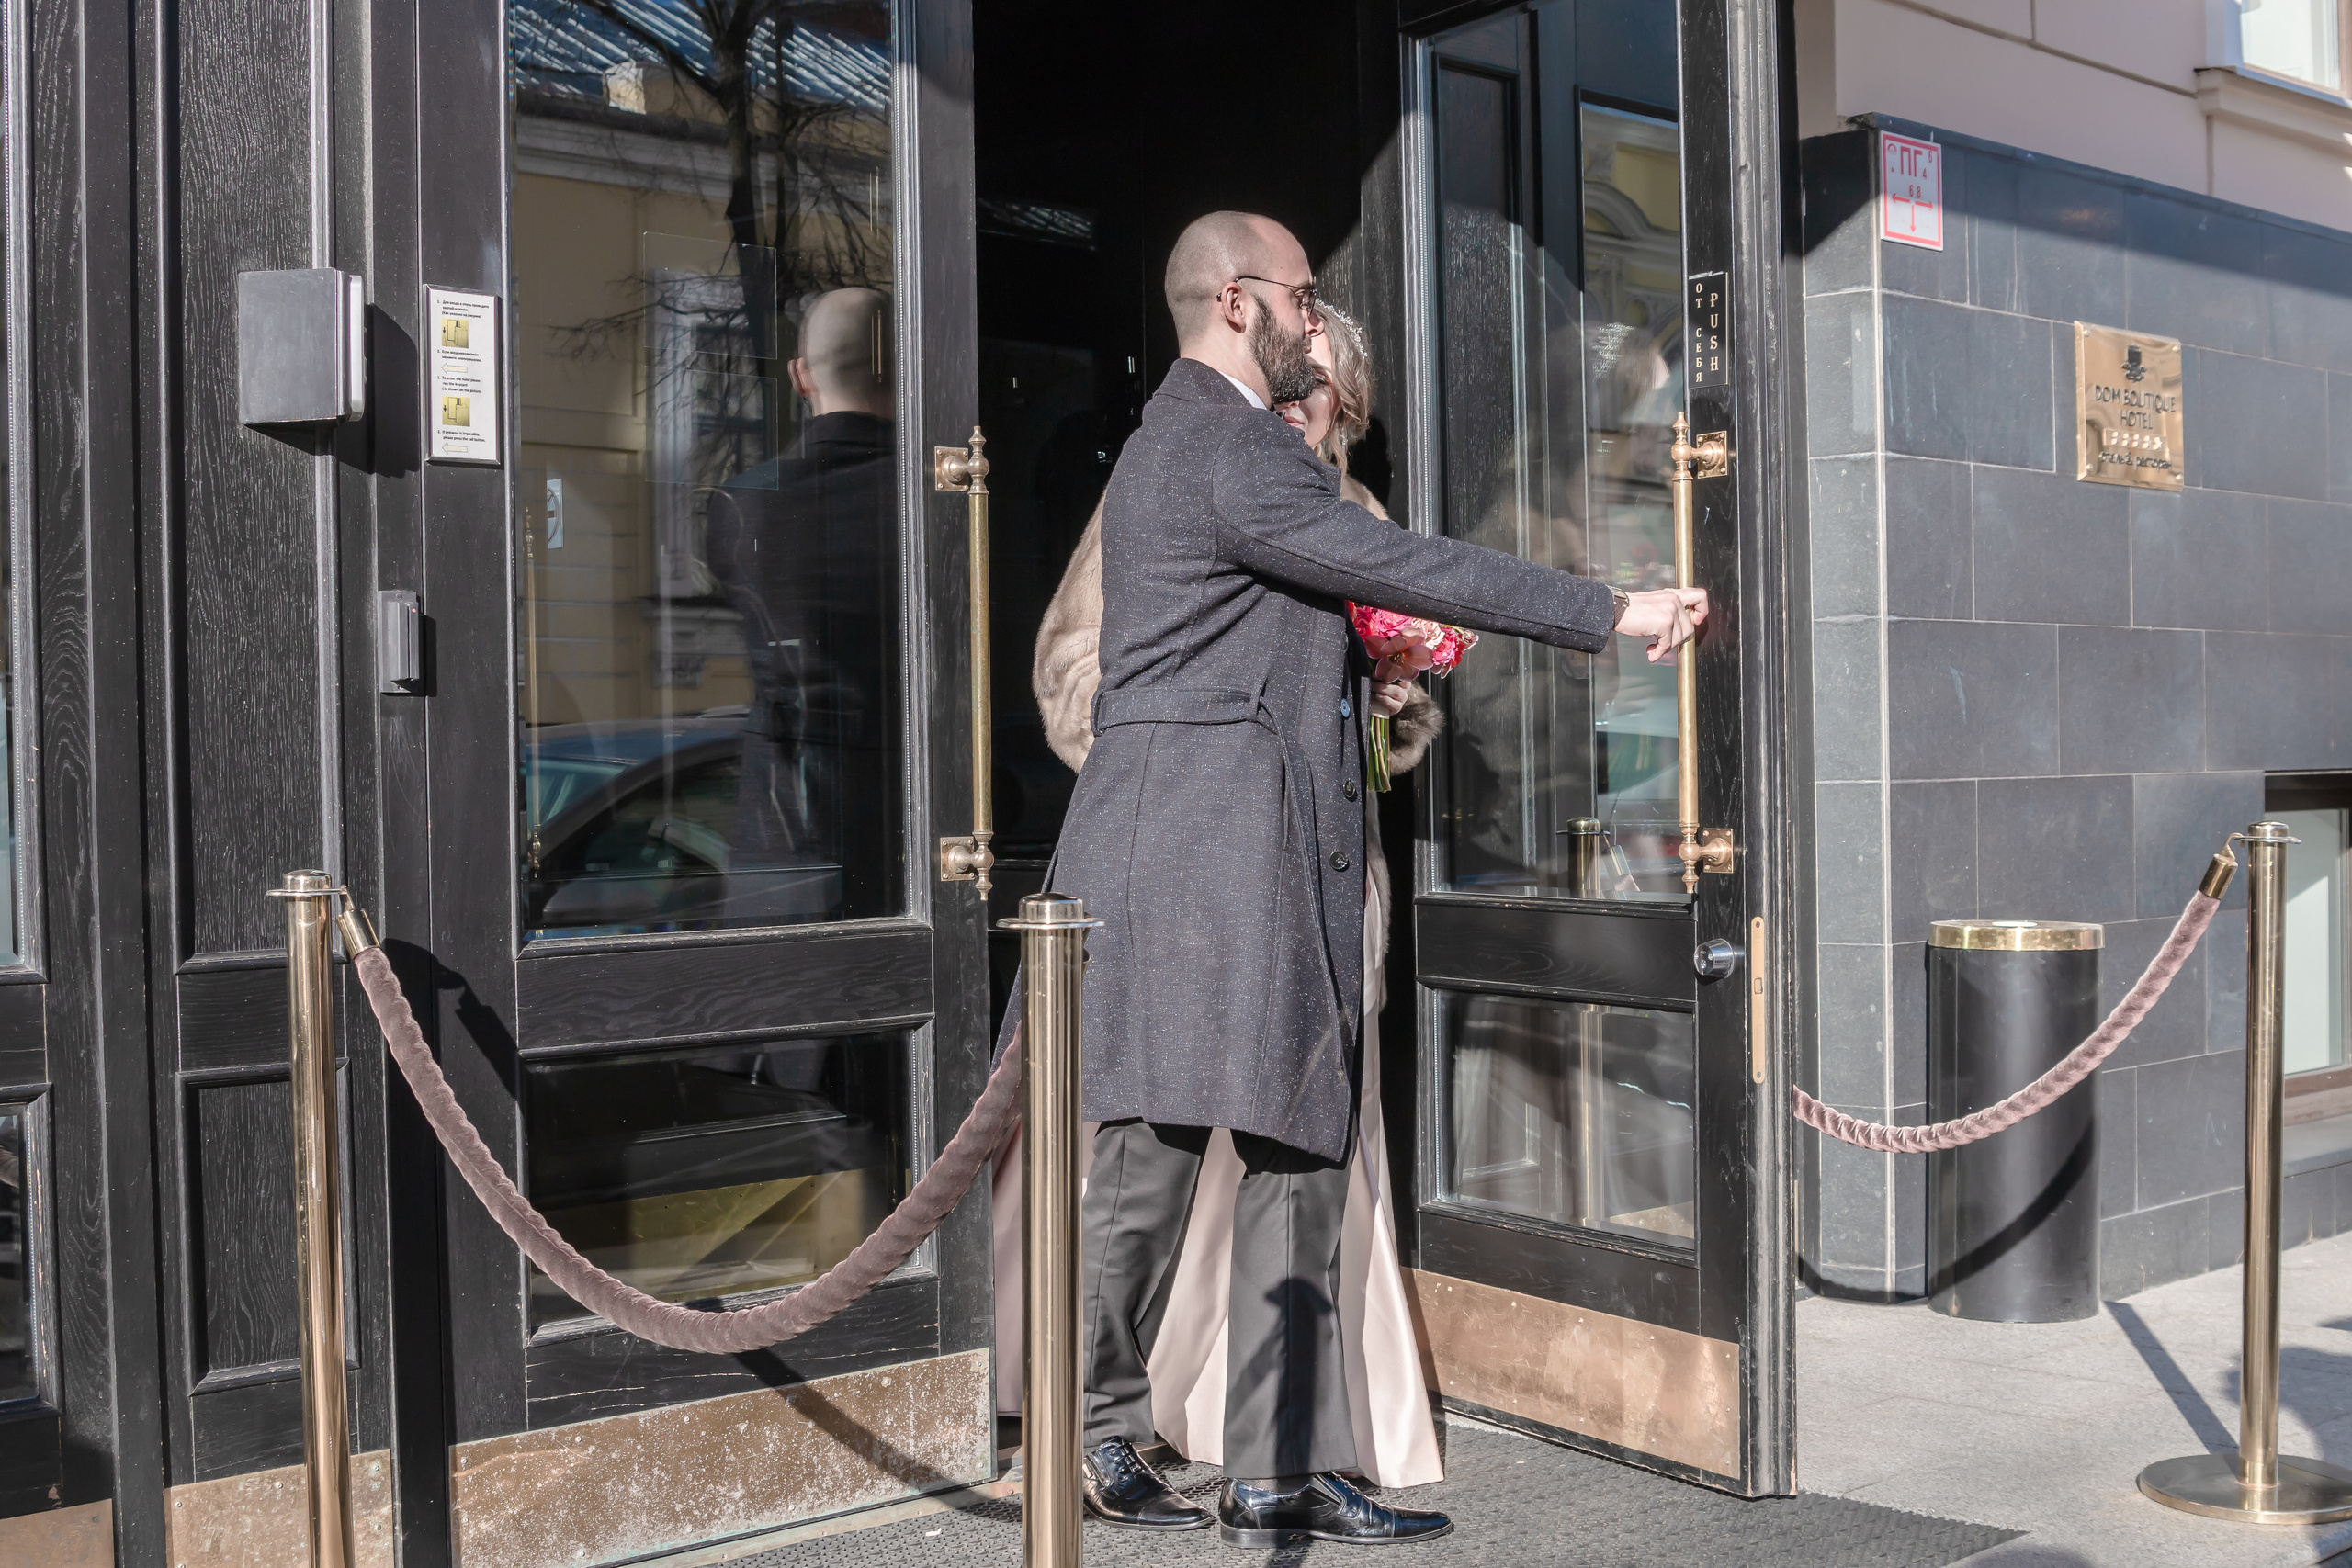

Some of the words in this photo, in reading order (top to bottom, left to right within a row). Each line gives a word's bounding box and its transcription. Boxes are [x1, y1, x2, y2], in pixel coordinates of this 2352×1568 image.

[1900, 146, 1923, 177] ПГ
[1710, 292, 1719, 372] PUSH
[2095, 384, 2121, 404] DOM
[2123, 389, 2177, 413] BOUTIQUE
[2120, 409, 2154, 430] HOTEL
